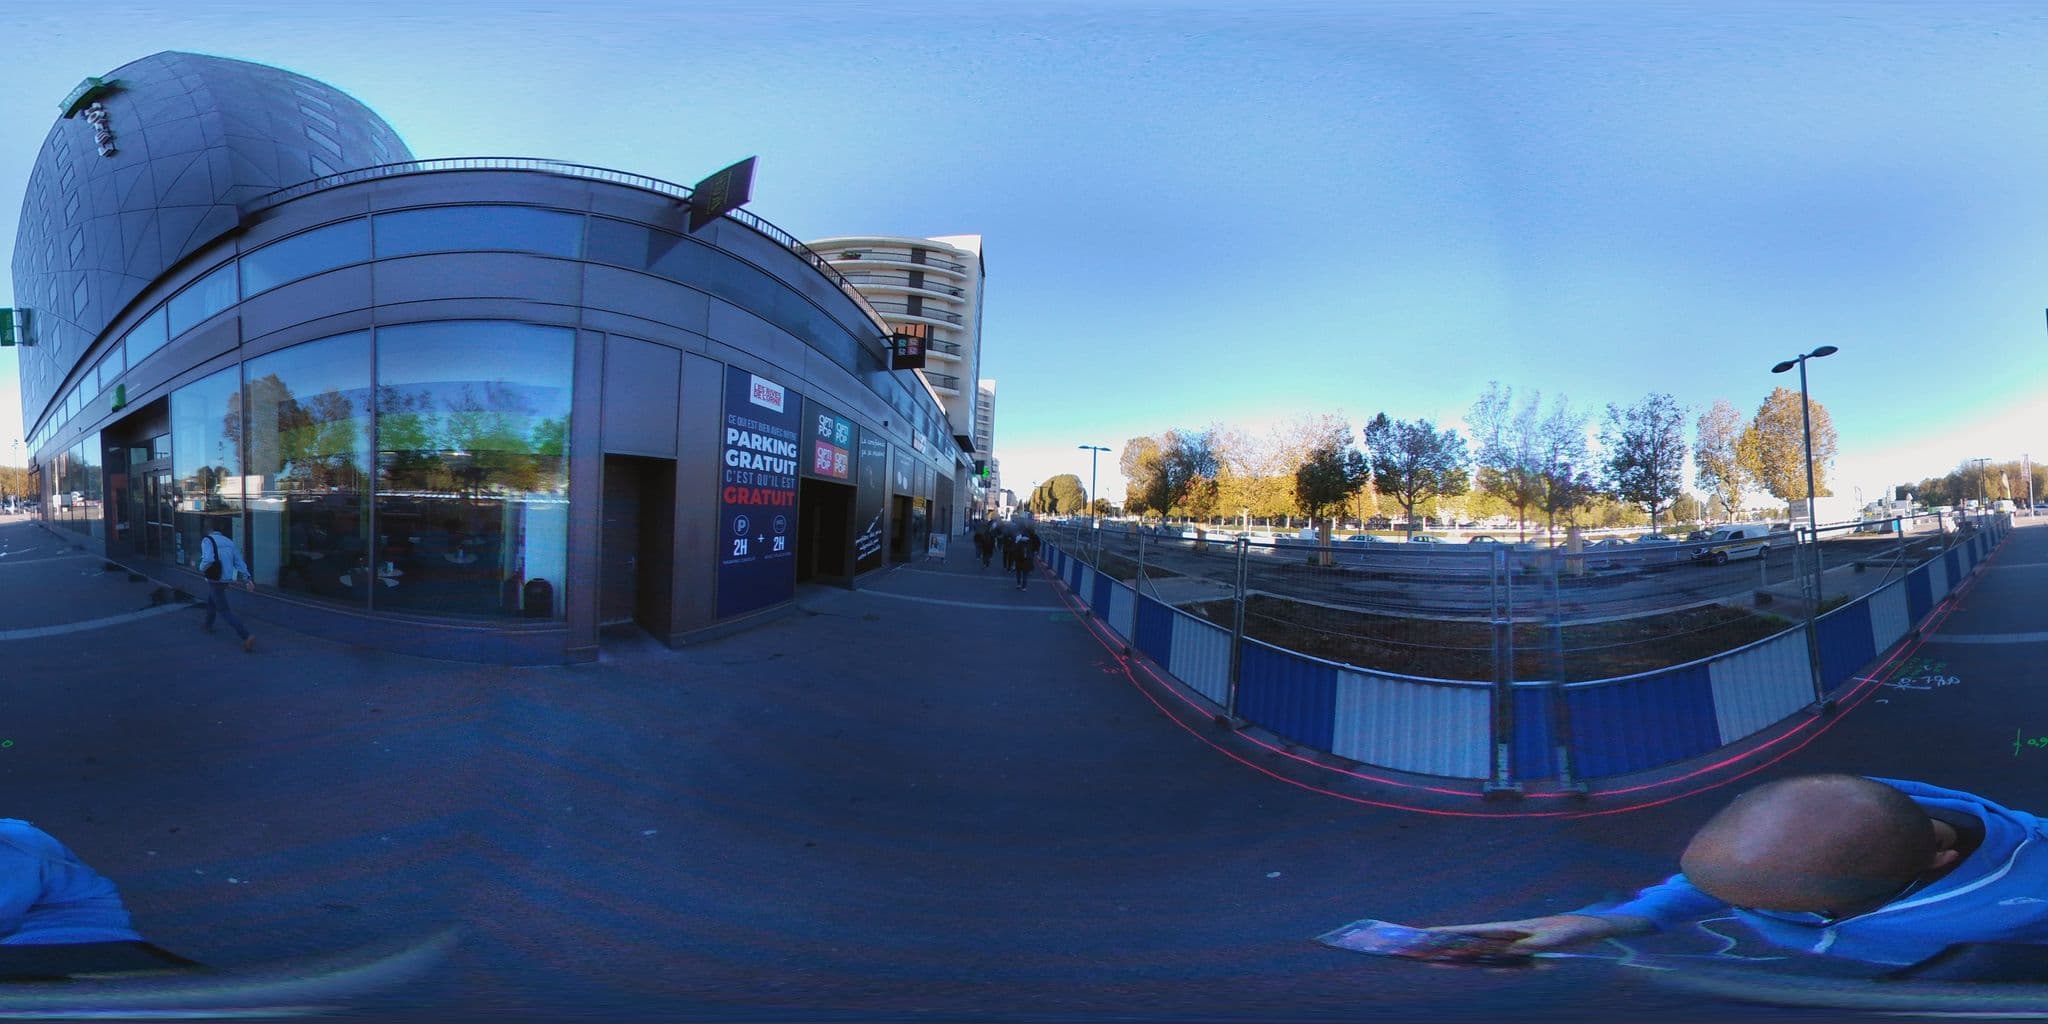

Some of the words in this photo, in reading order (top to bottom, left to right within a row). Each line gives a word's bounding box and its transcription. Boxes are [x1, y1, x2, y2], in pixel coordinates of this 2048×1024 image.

[728, 414, 737, 425] CE
[818, 425, 832, 438] POP
[835, 432, 848, 444] POP
[728, 428, 796, 458] PARKING
[726, 449, 796, 476] GRATUIT
[816, 457, 831, 470] POP
[834, 462, 846, 474] POP
[726, 470, 753, 484] C'EST
[757, 474, 778, 488] QU'IL
[782, 478, 796, 489] EST
[723, 485, 795, 506] GRATUIT
[733, 539, 748, 556] 2H
[773, 536, 784, 551] 2H
